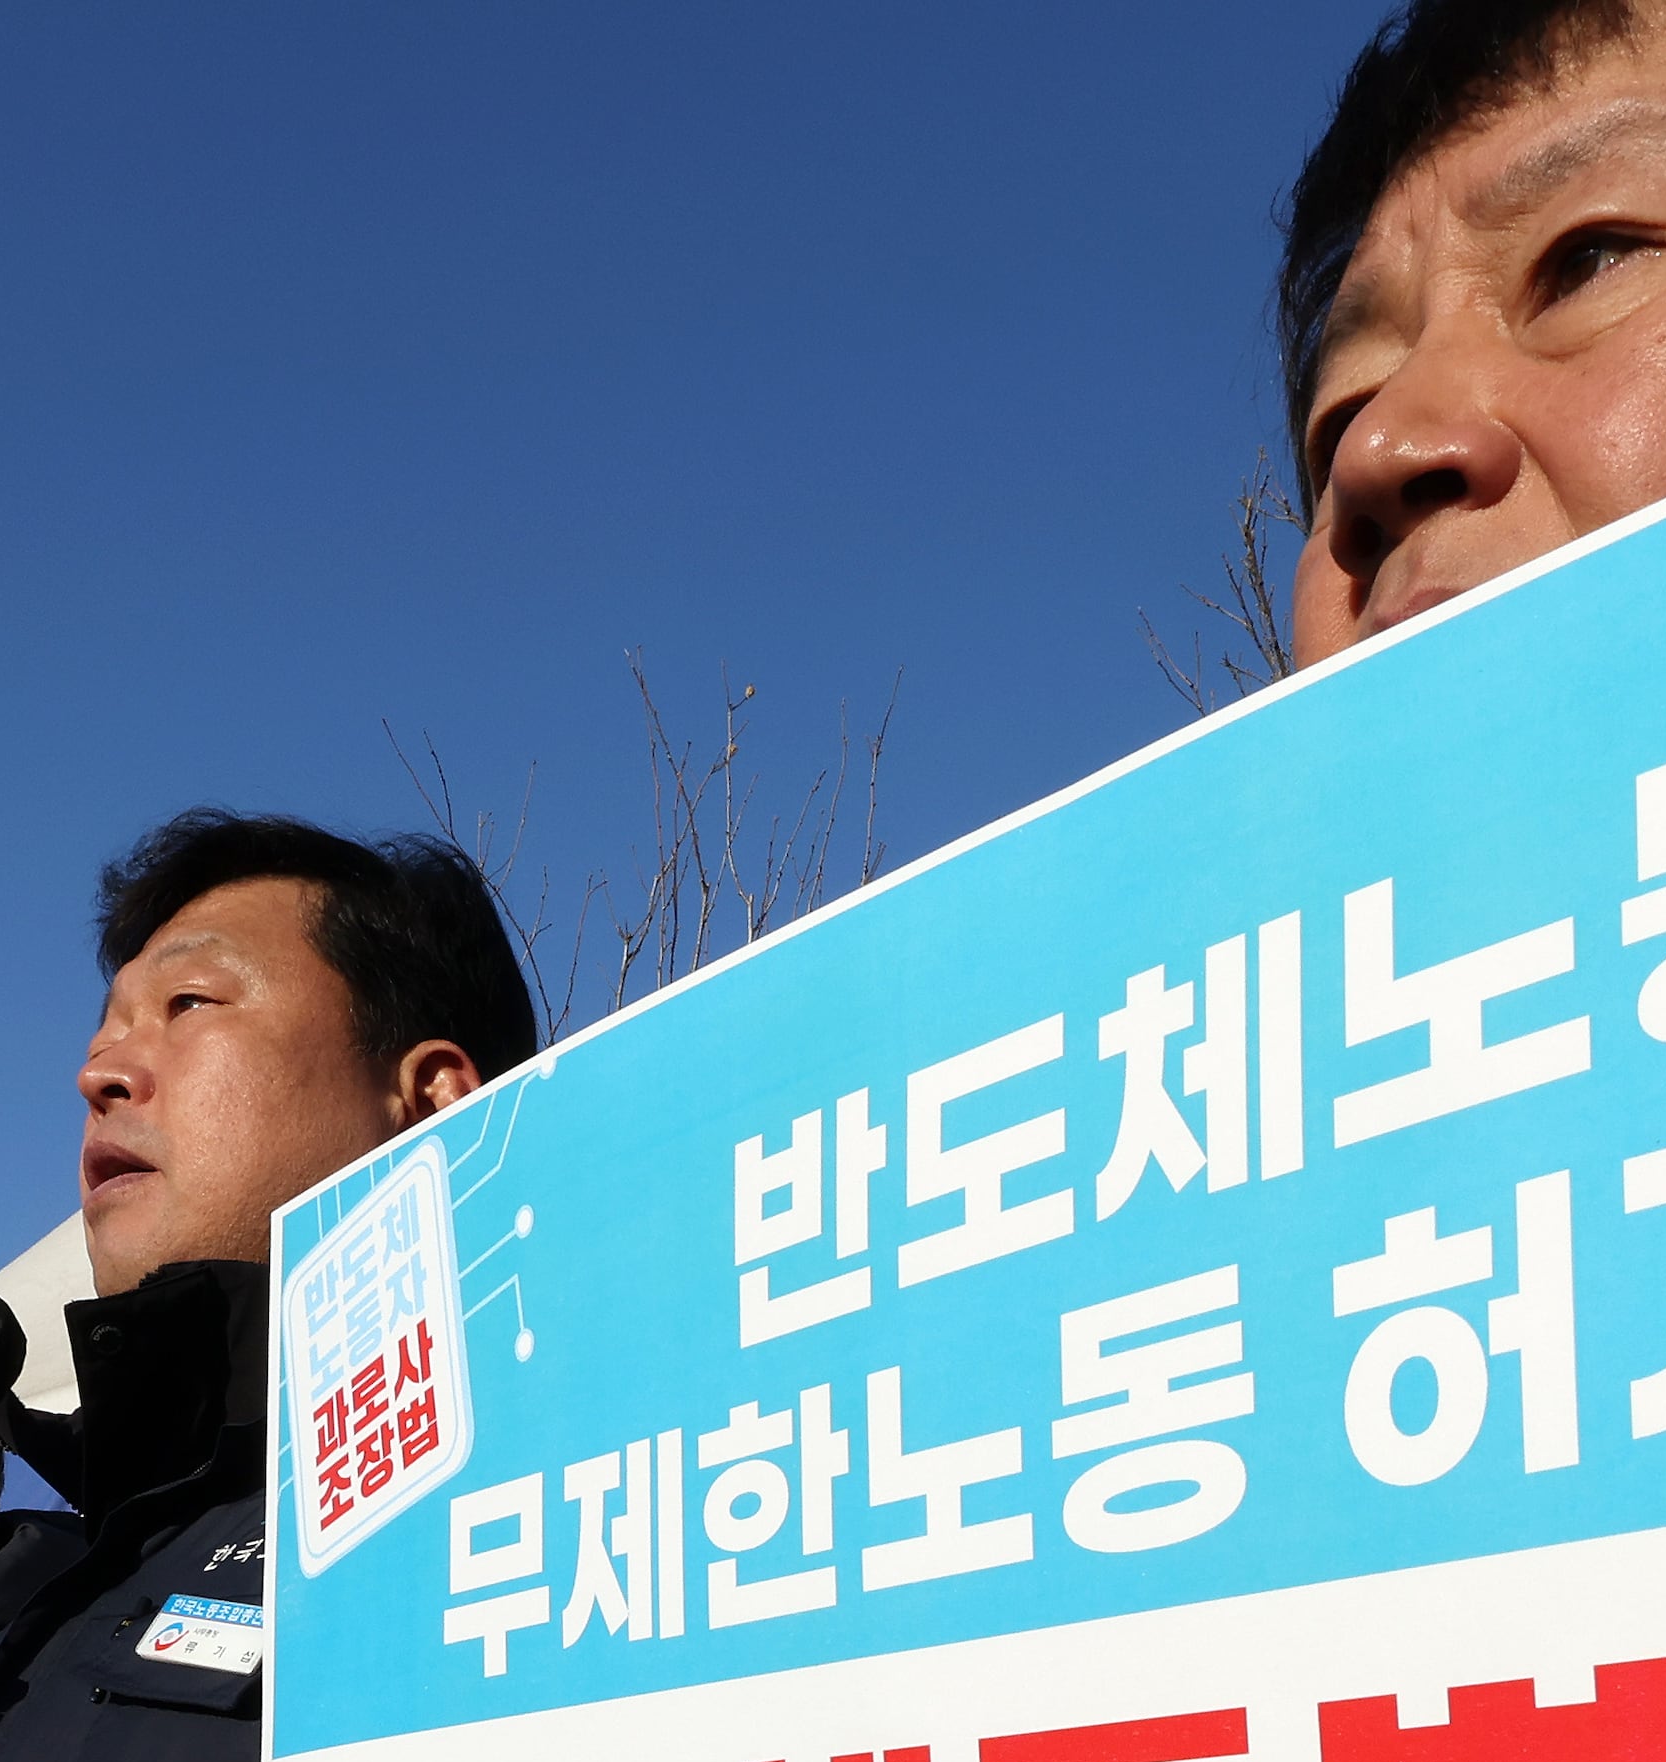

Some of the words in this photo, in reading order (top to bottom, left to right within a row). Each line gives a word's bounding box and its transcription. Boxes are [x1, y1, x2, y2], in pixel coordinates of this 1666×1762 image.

[305, 1183, 421, 1323] 반도체
[309, 1262, 427, 1400] 노동자
[313, 1317, 433, 1466] 과로사
[319, 1403, 437, 1532] 조장법
[442, 1264, 1259, 1680] 무제한노동
